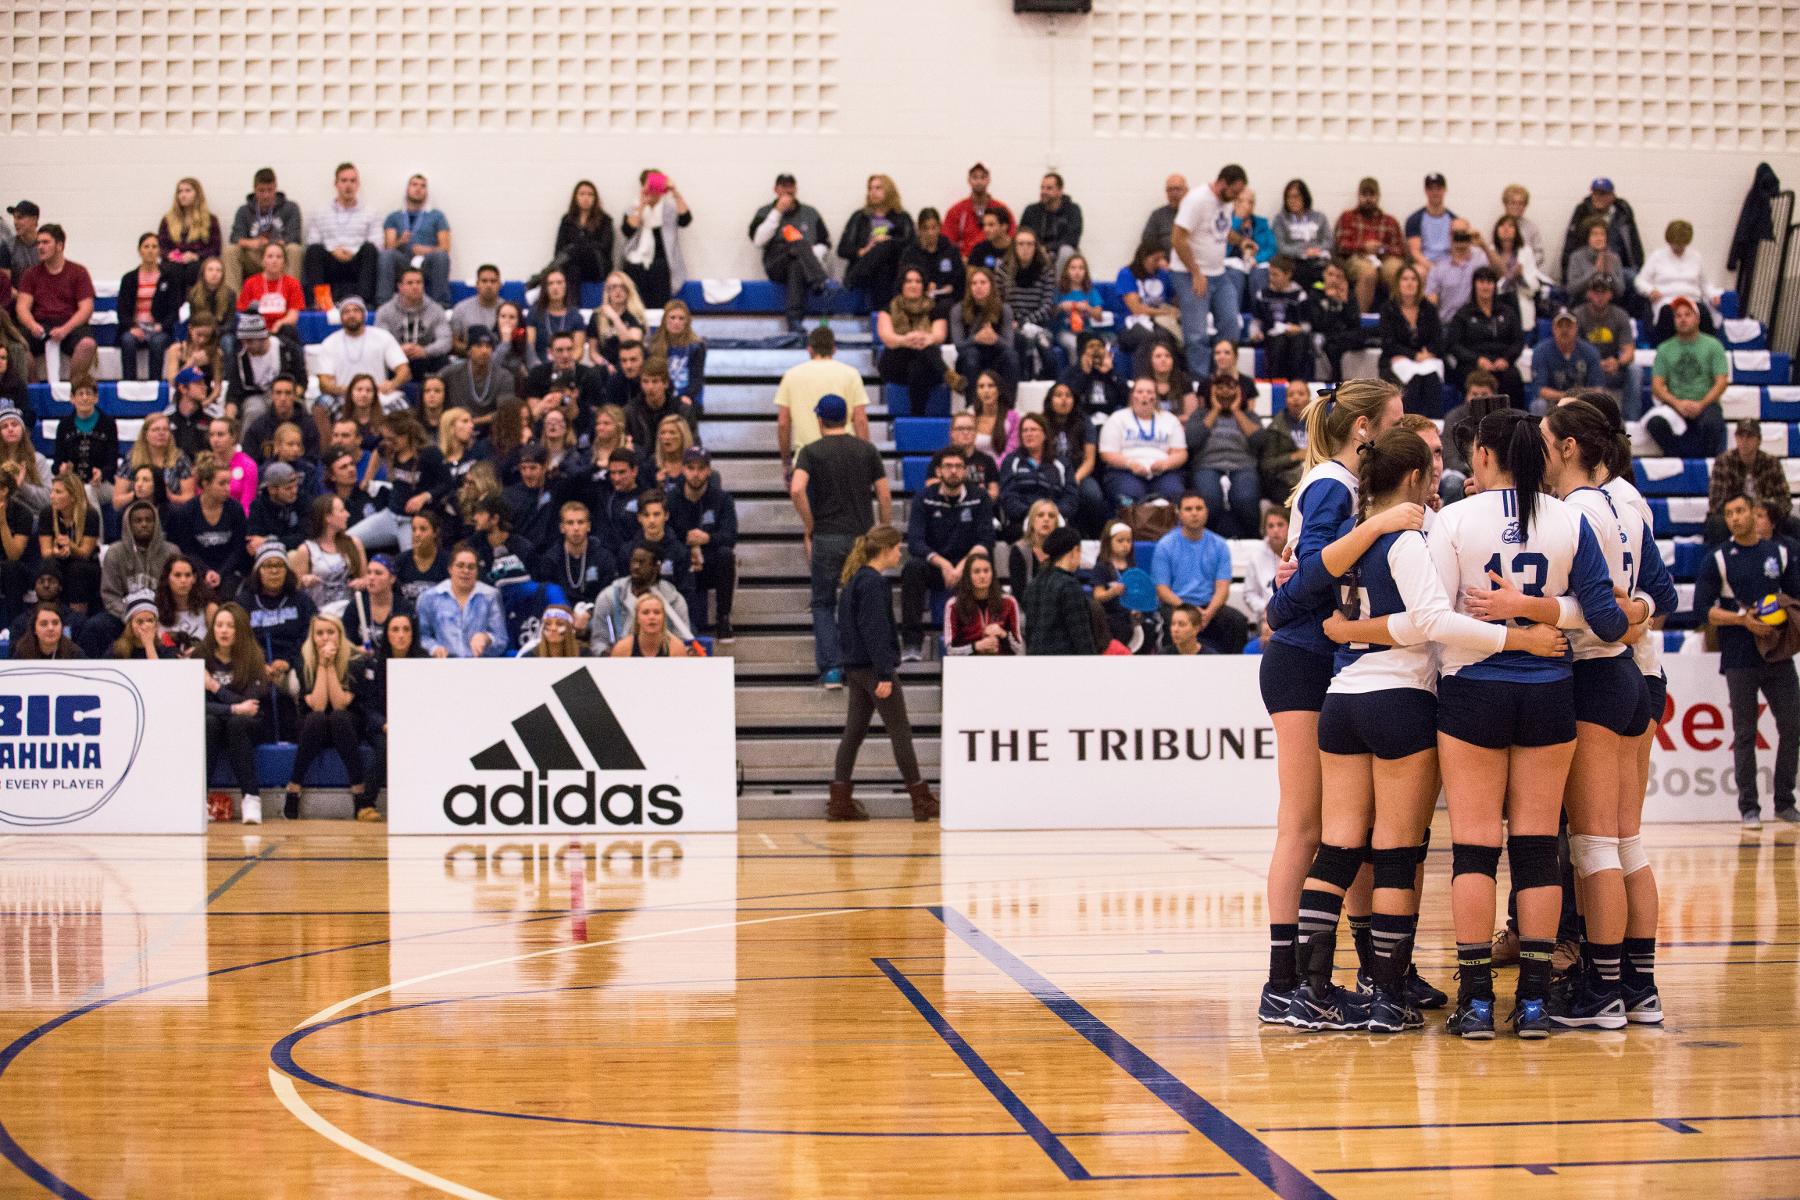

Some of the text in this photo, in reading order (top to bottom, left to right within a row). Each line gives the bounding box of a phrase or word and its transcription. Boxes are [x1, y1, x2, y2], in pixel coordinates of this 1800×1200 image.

[1484, 552, 1549, 626] 13
[0, 743, 101, 769] AHUNA
[959, 727, 1274, 762] THE TRIBUNE
[6, 779, 48, 790] EVERY
[53, 779, 104, 790] PLAYER
[443, 771, 684, 826] adidas
